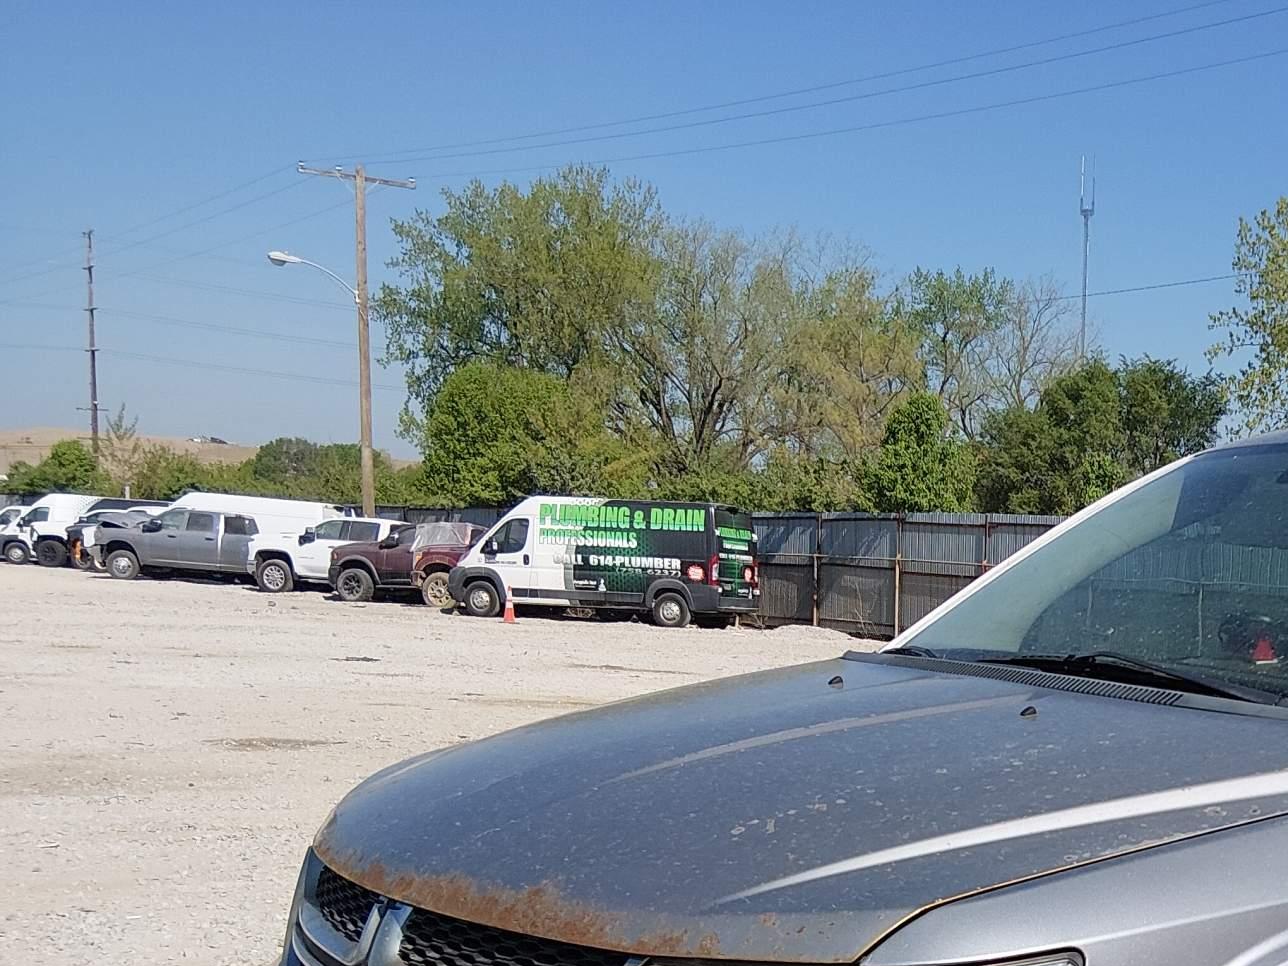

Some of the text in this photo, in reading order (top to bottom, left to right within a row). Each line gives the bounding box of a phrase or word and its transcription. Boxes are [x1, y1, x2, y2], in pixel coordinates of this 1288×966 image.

[539, 503, 705, 532] PLUMBING & DRAIN
[538, 528, 638, 548] PROFESSIONALS
[553, 552, 682, 570] CALL 614-PLUMBER
